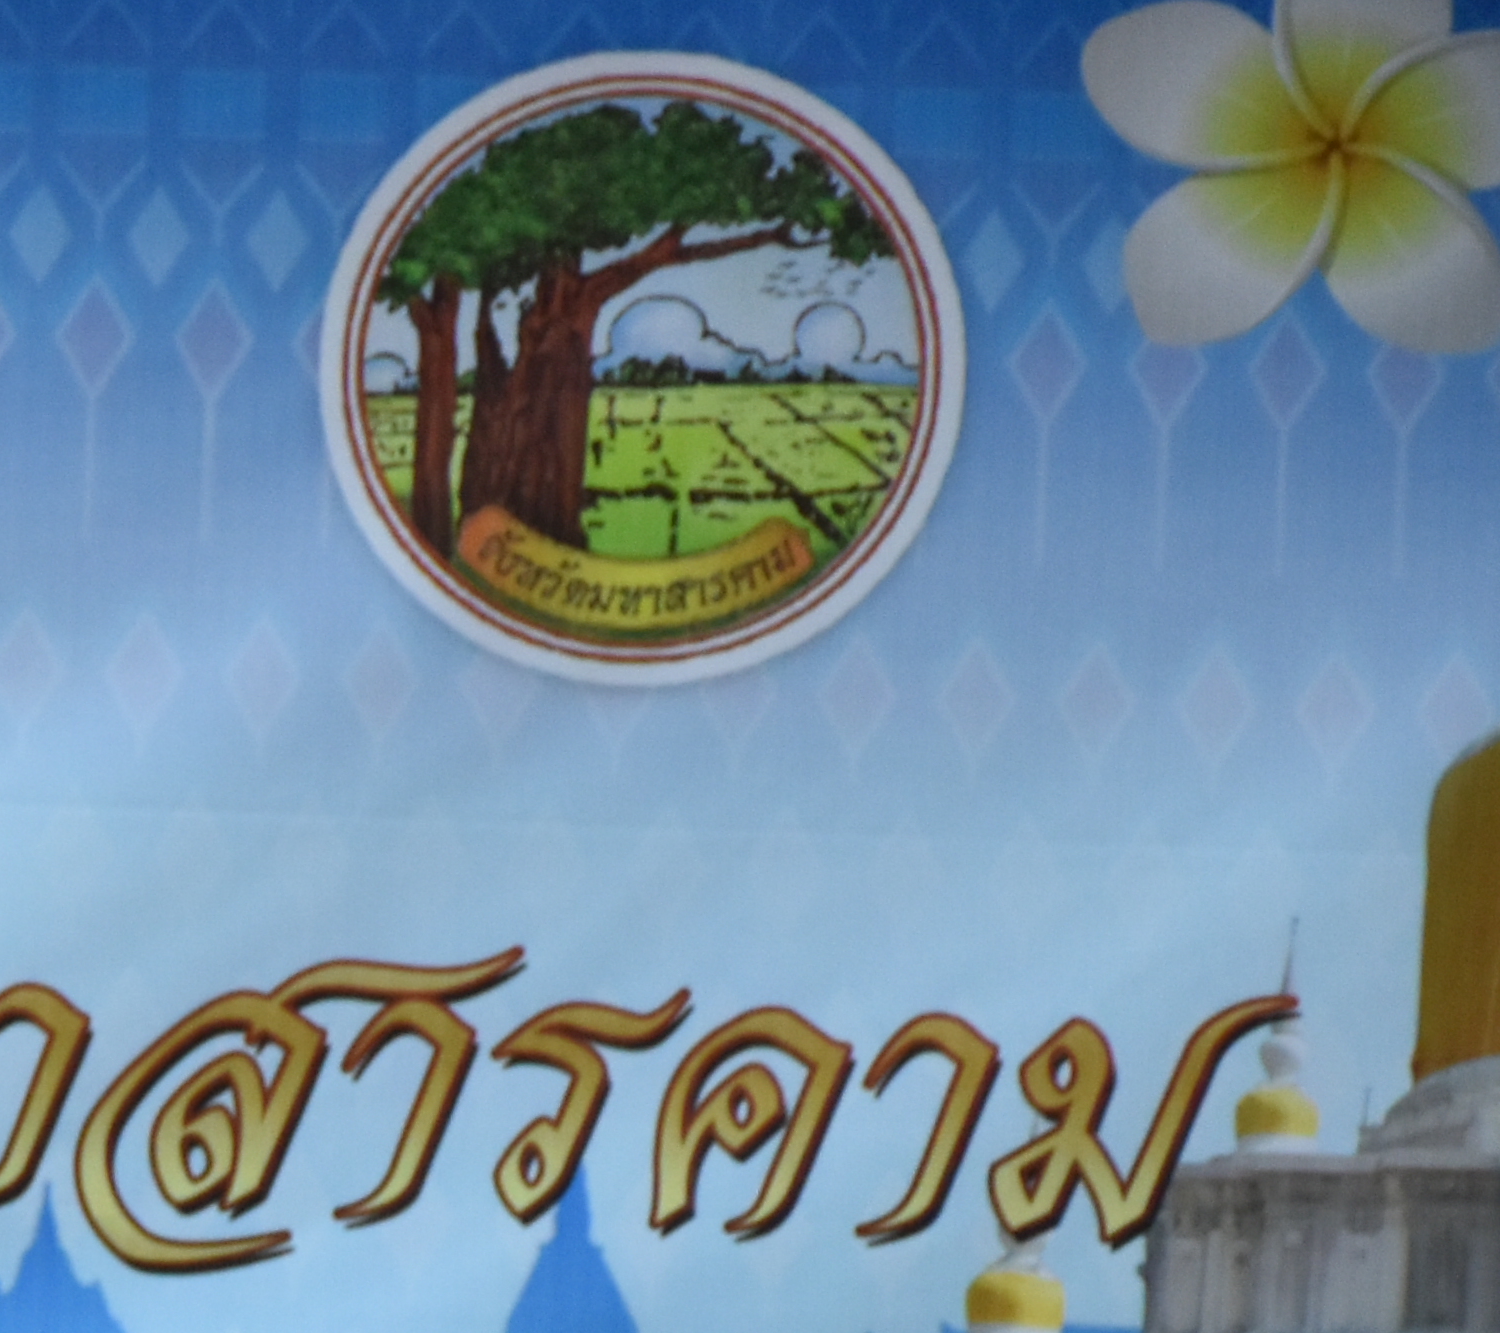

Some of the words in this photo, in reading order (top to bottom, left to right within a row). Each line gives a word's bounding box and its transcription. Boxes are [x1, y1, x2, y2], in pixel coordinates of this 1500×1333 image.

[477, 529, 797, 616] จังหวัดมหาสารคาม
